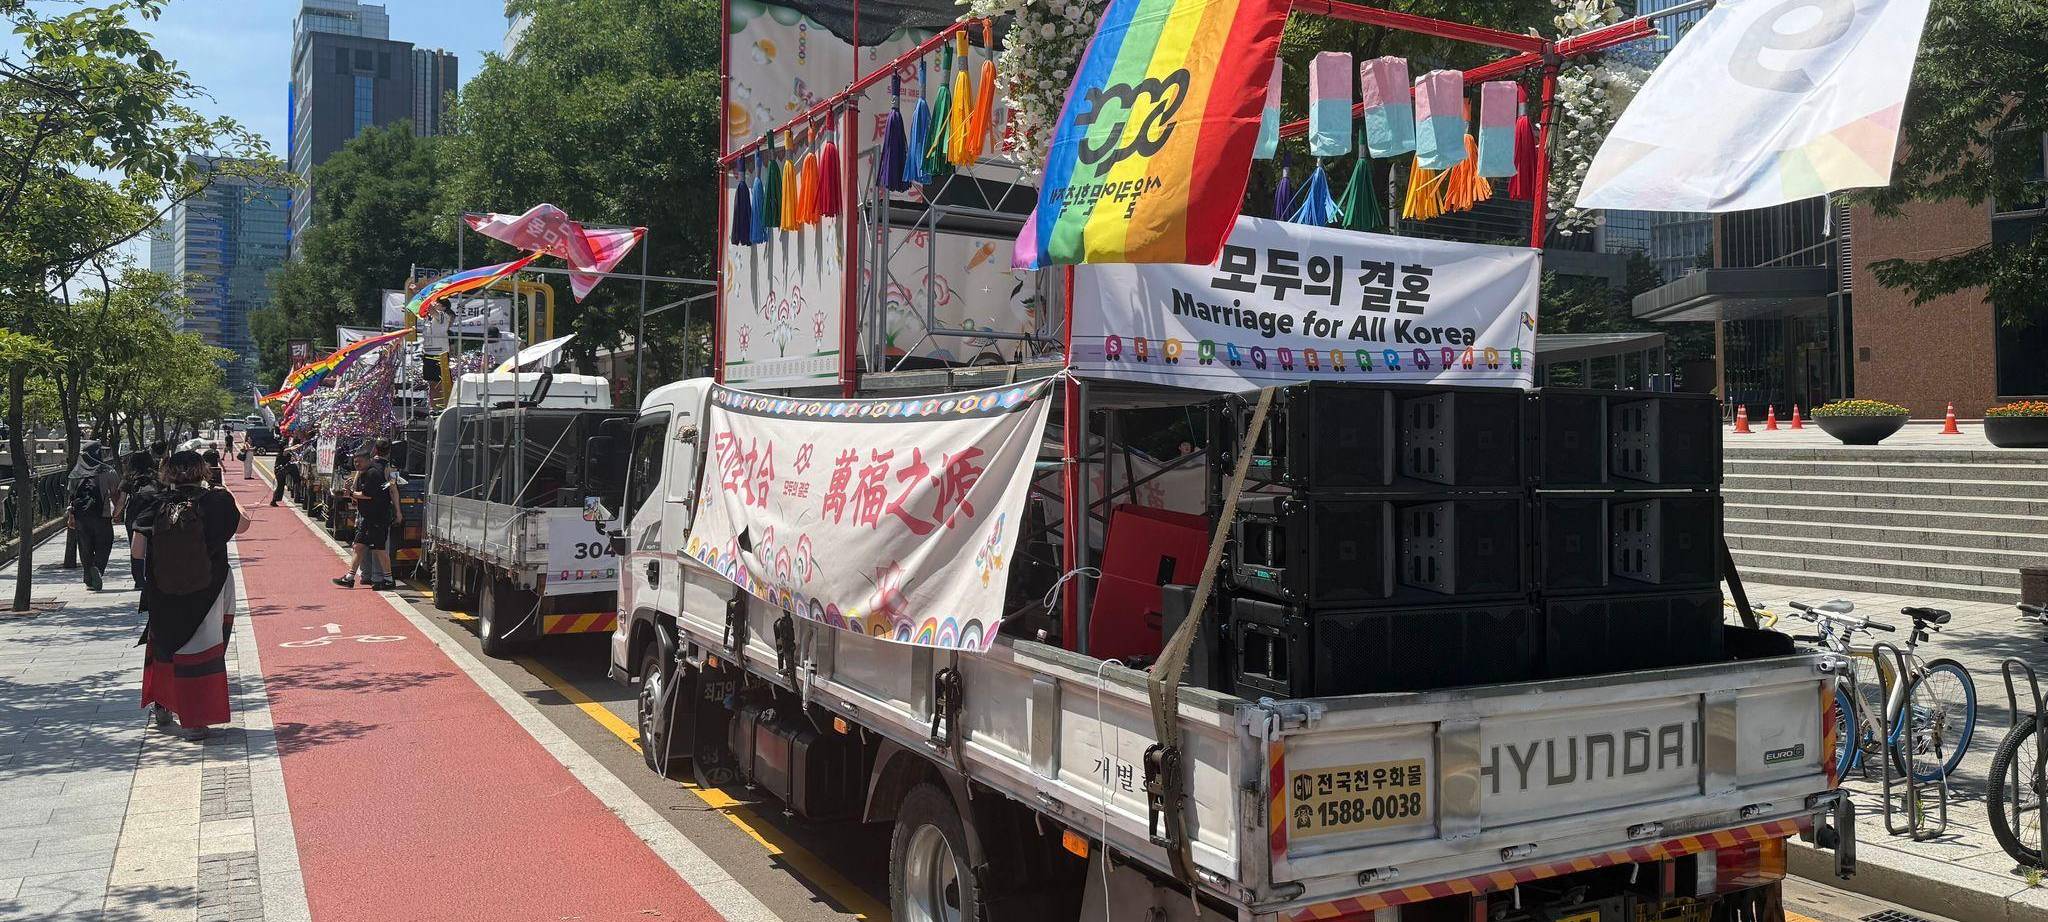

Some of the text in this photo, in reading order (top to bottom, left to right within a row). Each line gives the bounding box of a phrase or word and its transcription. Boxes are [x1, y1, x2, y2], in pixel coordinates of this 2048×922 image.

[1210, 244, 1434, 315] 모두의 결혼
[1171, 288, 1476, 346] Marriage for All Korea
[821, 446, 985, 536] 萬福之源
[1317, 764, 1422, 796] 전국천우화물
[1318, 792, 1422, 827] 1588-0038
